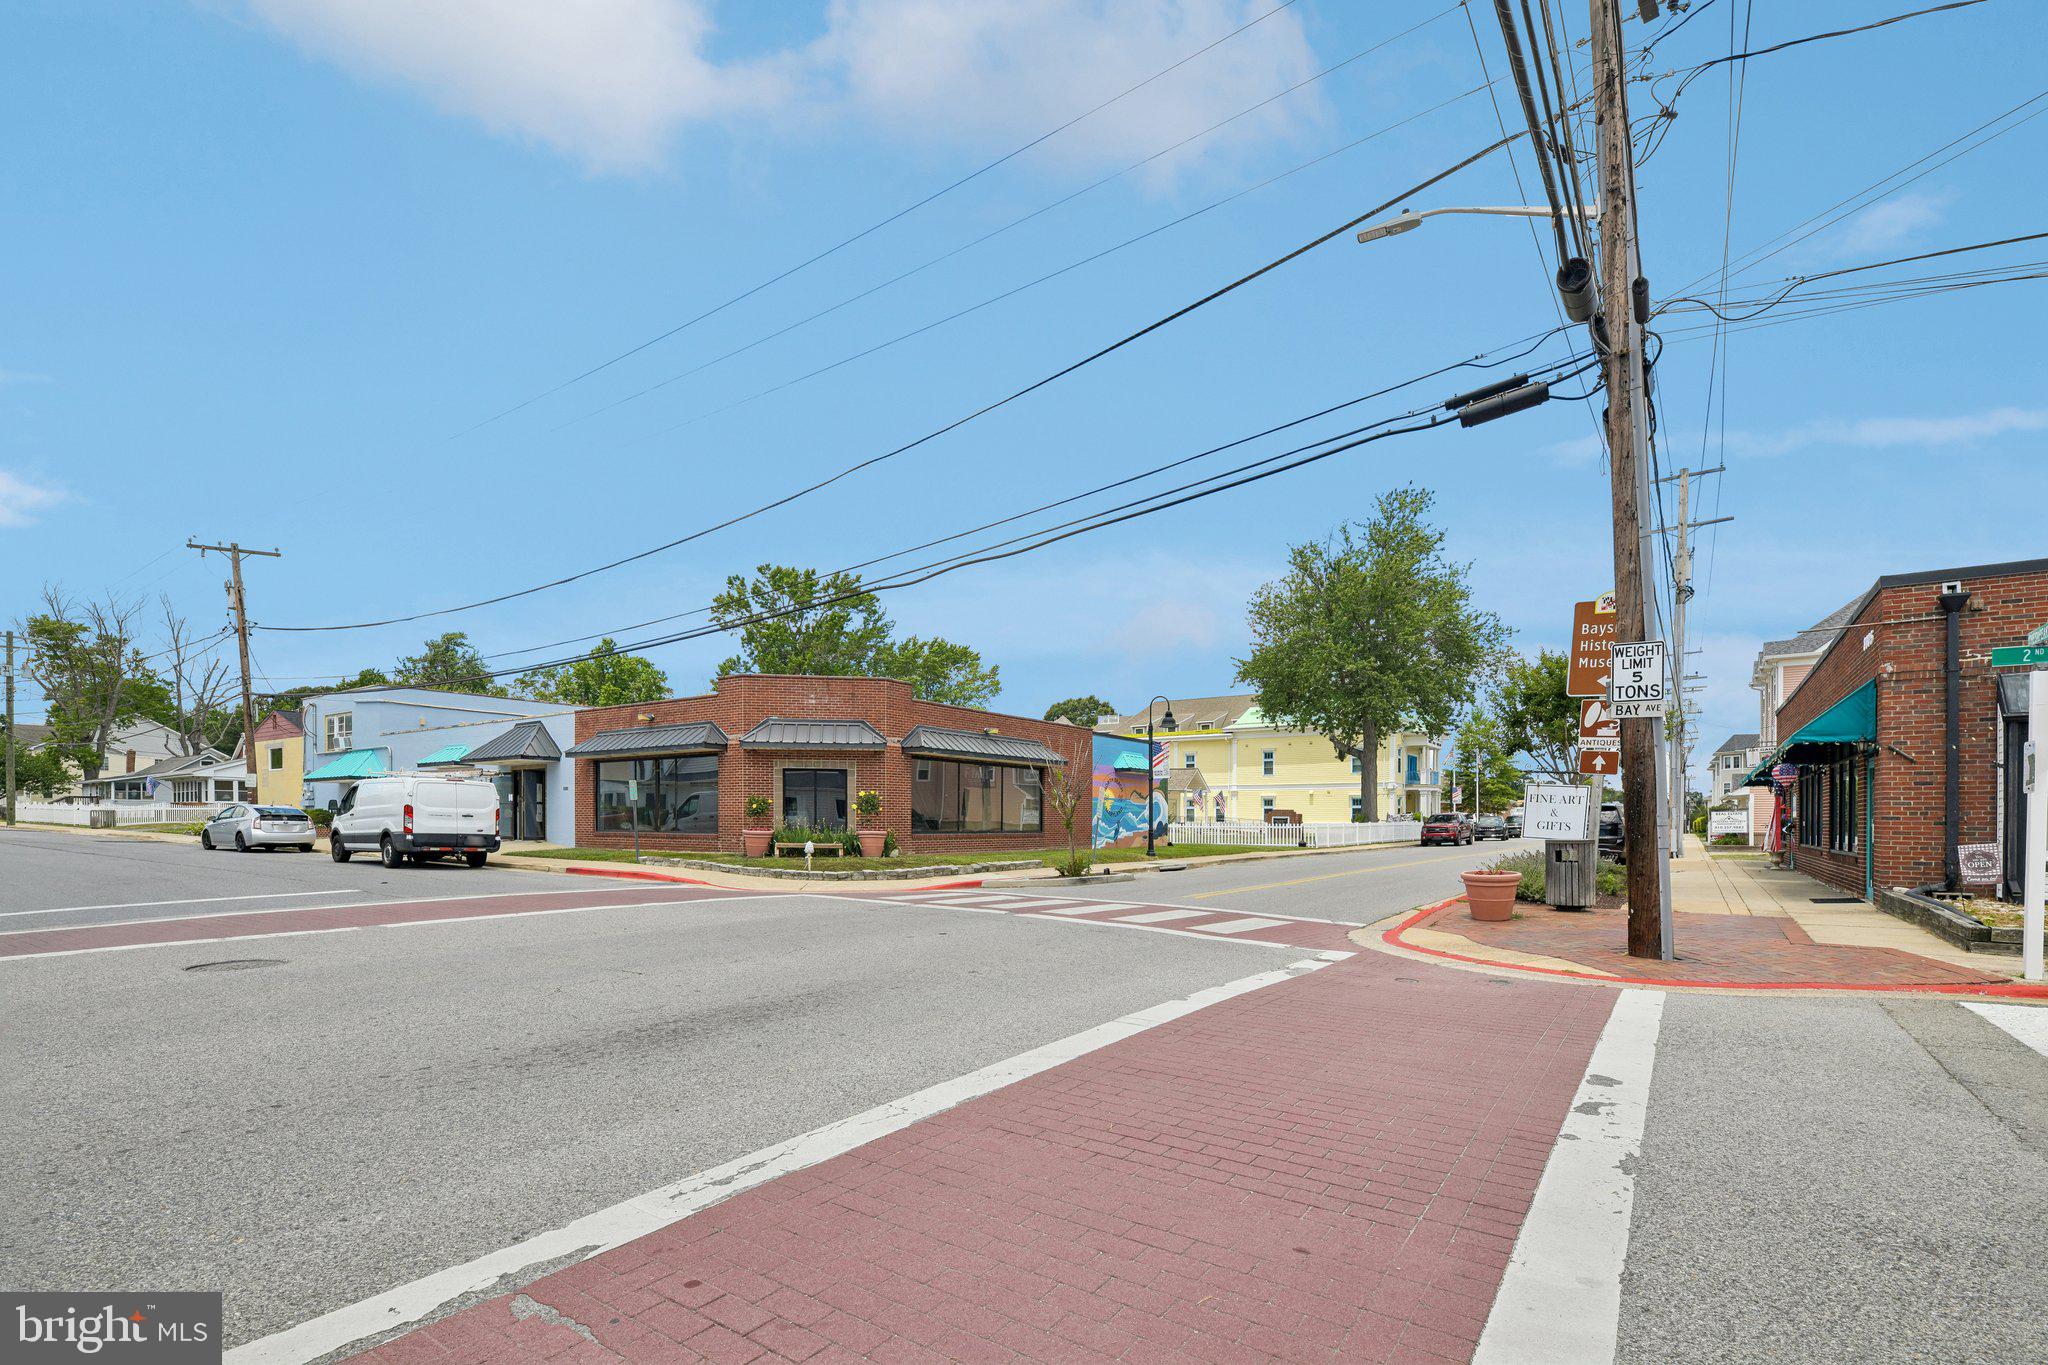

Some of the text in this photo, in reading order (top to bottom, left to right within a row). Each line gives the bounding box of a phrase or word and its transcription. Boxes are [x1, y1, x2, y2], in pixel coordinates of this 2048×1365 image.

[1614, 644, 1662, 658] WEIGHT
[2023, 648, 2045, 662] 2 ND
[1621, 657, 1654, 669] LIMIT
[1632, 671, 1643, 683] 5
[1615, 684, 1661, 699] TONS
[1615, 704, 1662, 716] BAY AVE
[1529, 794, 1584, 805] FINE ART
[1550, 808, 1559, 817] &
[1536, 821, 1571, 831] GIFTS
